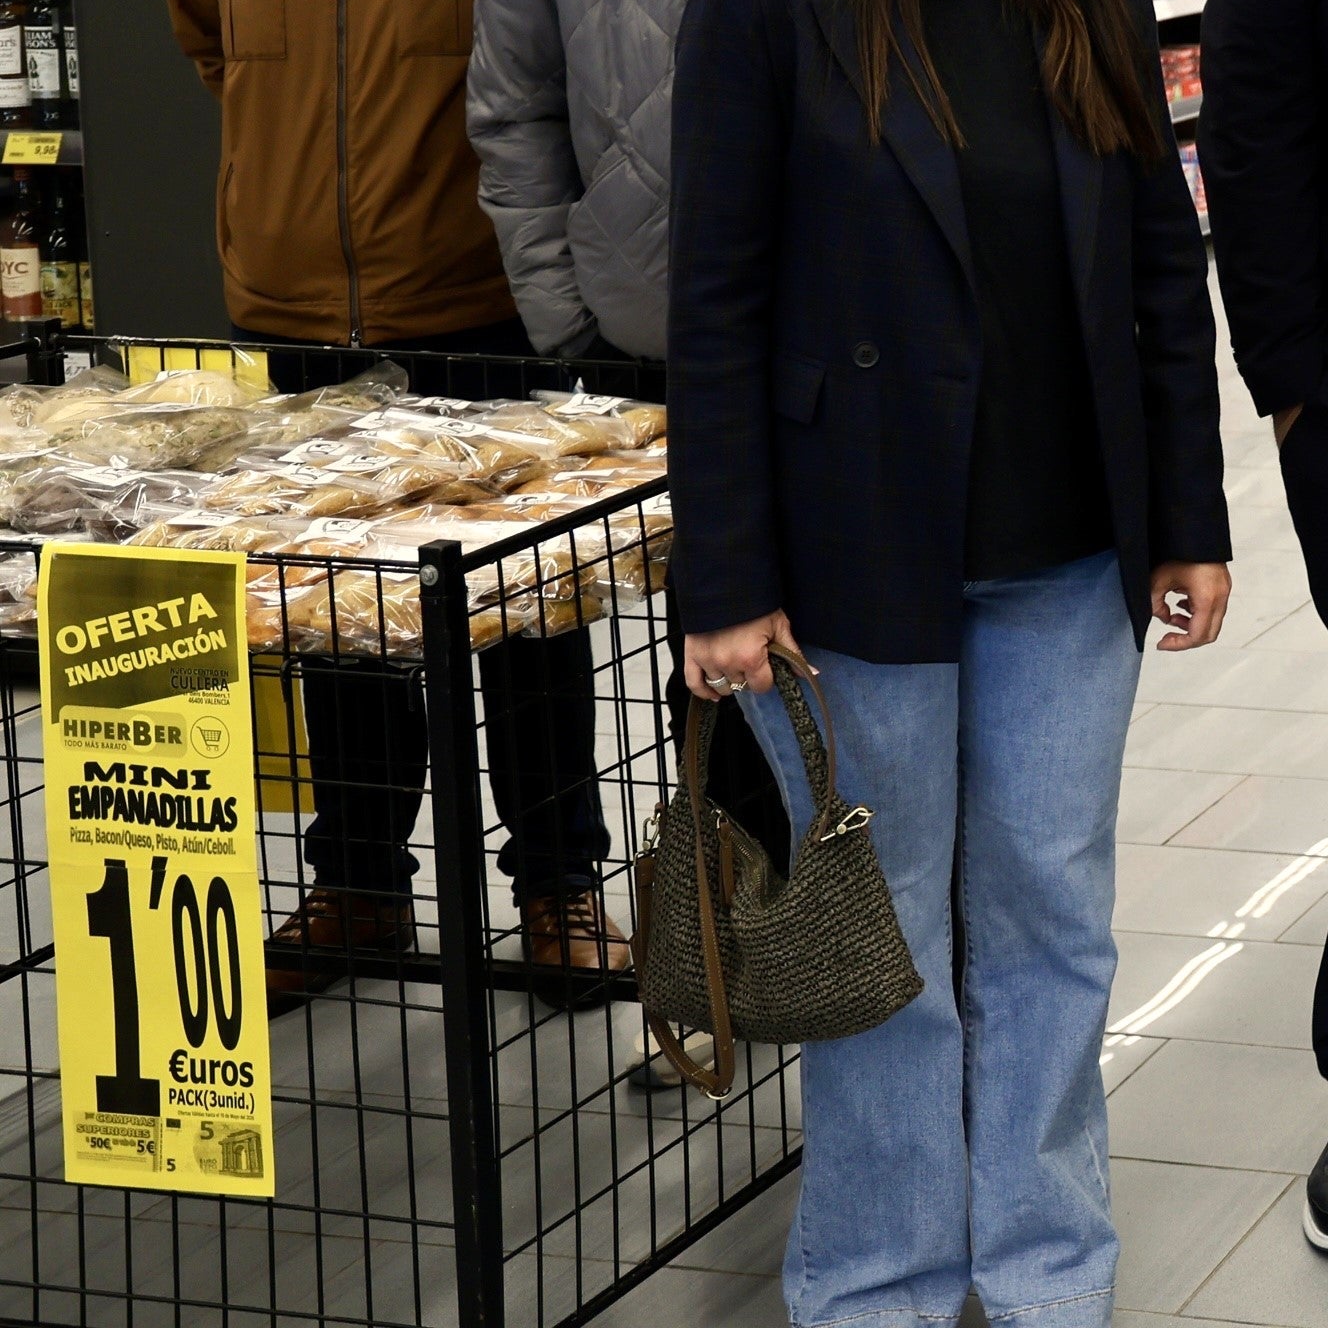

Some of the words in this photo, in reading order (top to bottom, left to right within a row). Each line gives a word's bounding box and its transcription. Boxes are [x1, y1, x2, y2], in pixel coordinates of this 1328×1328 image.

[55, 592, 218, 656] OFERTA
[64, 628, 228, 688] INAUGURACIÓN
[171, 675, 230, 692] CULLERA
[63, 718, 183, 747] HIPERBER
[64, 739, 84, 748] TODO
[101, 741, 128, 751] BARATO
[83, 761, 212, 791] MINI
[68, 785, 238, 833] EMPANADILLAS
[70, 828, 94, 846] Pizza,
[95, 828, 155, 852] Bacon/Queso,
[155, 832, 181, 854] Pisto,
[182, 834, 237, 856] Atún/Ceboll.
[168, 1048, 254, 1088] €uros
[168, 1088, 256, 1115] PACK(3unid.)
[76, 1124, 151, 1139] SUPERIORES
[96, 1114, 155, 1127] COMPRAS
[166, 1158, 176, 1173] 5
